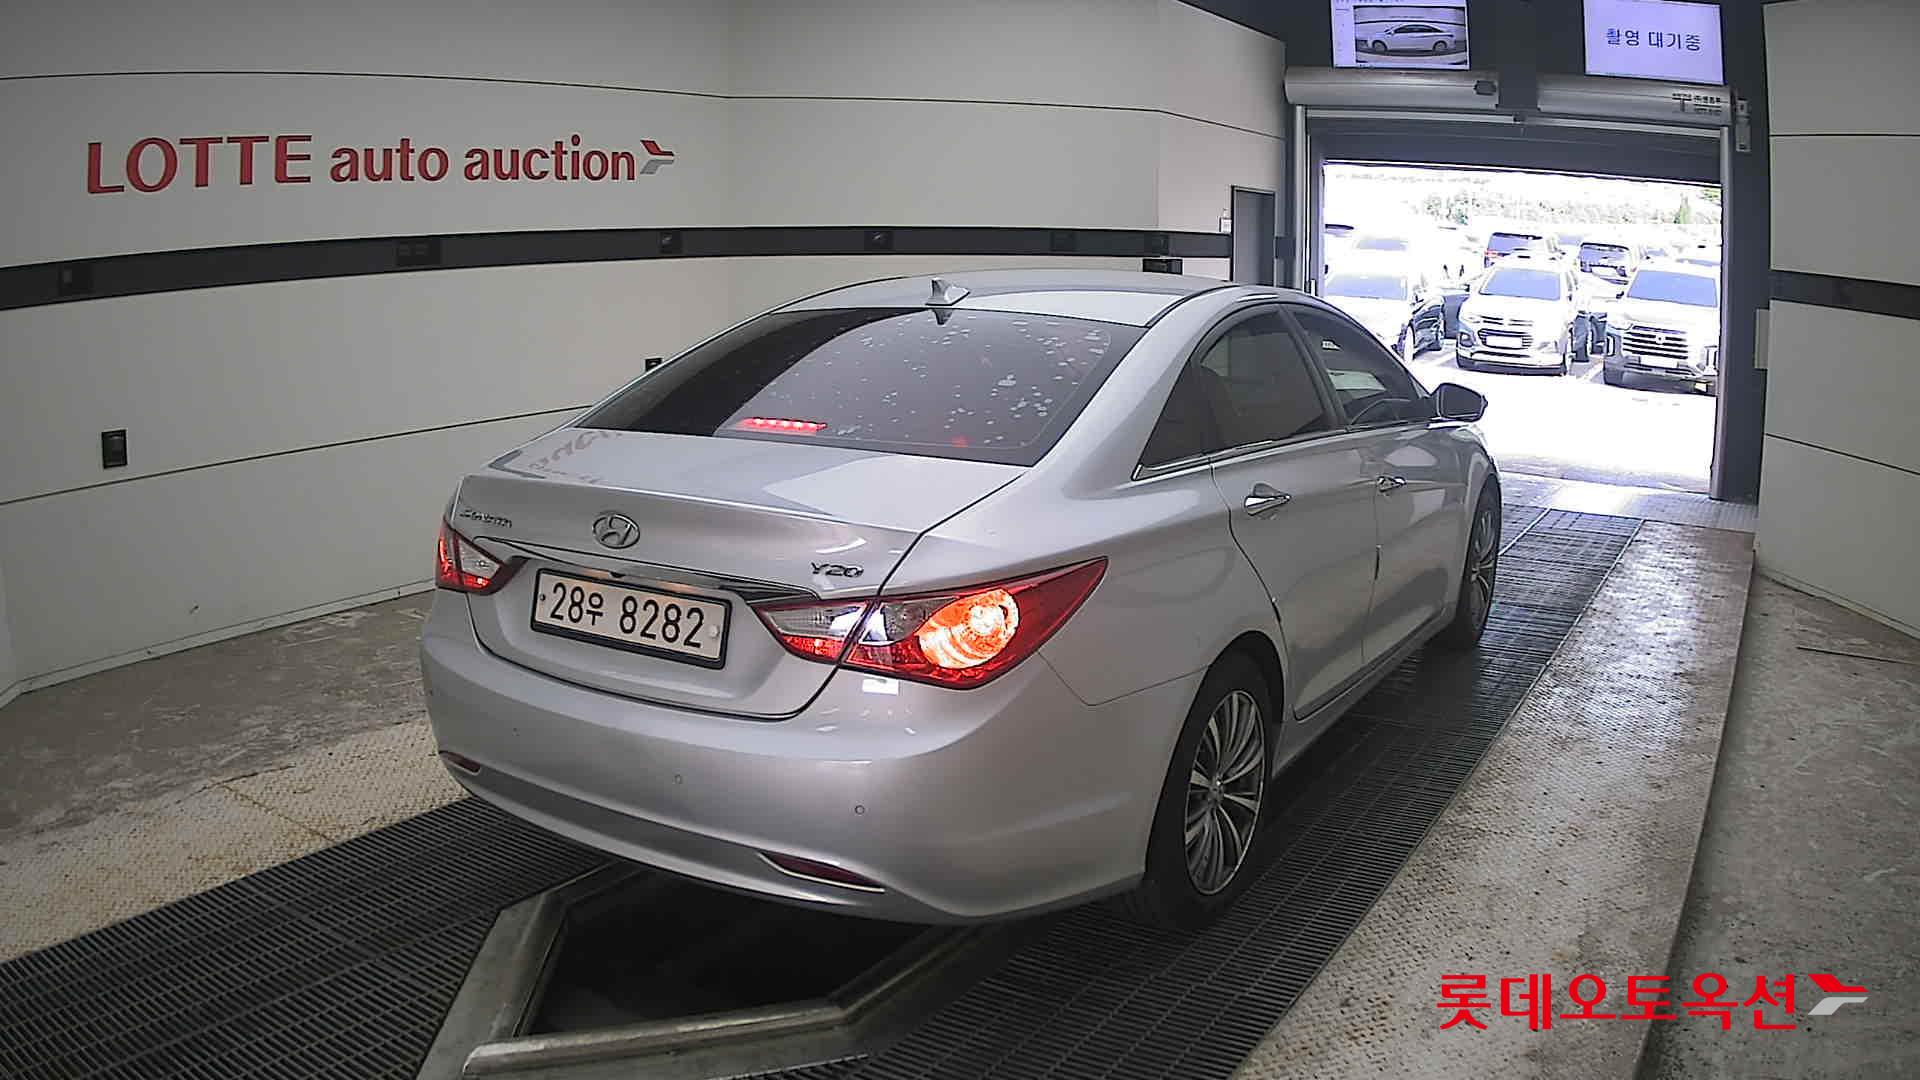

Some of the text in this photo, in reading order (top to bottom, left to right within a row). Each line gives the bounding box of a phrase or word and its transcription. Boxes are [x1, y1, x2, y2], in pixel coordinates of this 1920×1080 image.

[1648, 31, 1701, 52] 대기중
[86, 134, 636, 195] LOTTE auto auction
[550, 582, 704, 648] 28우 8282
